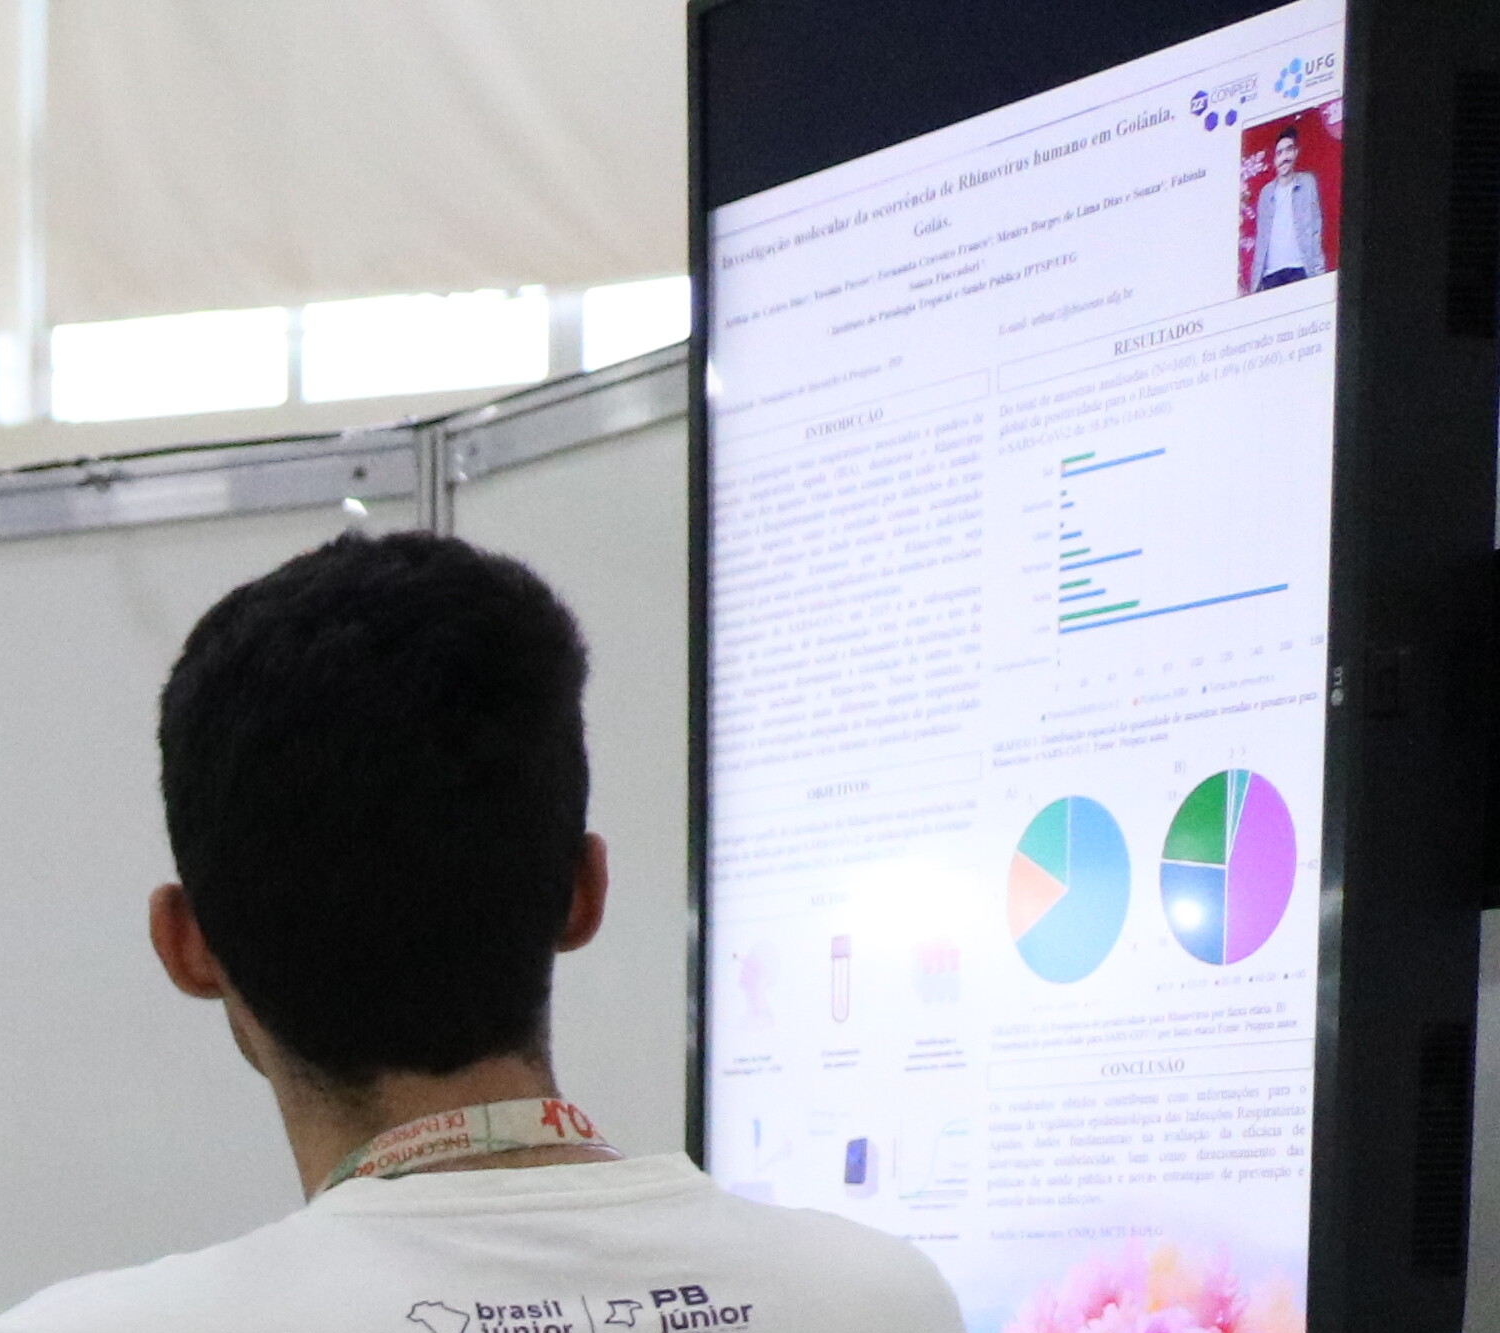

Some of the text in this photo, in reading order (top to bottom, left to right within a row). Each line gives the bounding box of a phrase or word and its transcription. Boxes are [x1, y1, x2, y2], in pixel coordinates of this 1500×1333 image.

[1305, 53, 1335, 75] UFG
[794, 217, 849, 246] molecular
[854, 209, 868, 226] da
[940, 180, 953, 197] de
[1034, 138, 1087, 166] humano
[1091, 130, 1111, 147] em
[1116, 109, 1175, 138] Goiânia,
[1114, 319, 1203, 356] RESULTADOS
[1220, 333, 1274, 359] observado
[1105, 395, 1125, 412] para
[1197, 369, 1209, 384] de
[1298, 343, 1322, 361] para
[1101, 1058, 1185, 1077] CONCLUSÃO
[1197, 1085, 1259, 1100] informações
[1268, 1086, 1290, 1098] para
[1299, 1085, 1306, 1093] o
[1220, 1127, 1231, 1139] da
[1293, 1124, 1305, 1135] de
[1197, 1146, 1276, 1160] direcionamento
[1286, 1145, 1304, 1156] das
[1221, 1167, 1233, 1179] de
[1238, 1166, 1291, 1181] prevenção
[1298, 1168, 1304, 1176] e
[648, 1285, 709, 1307] PB
[475, 1300, 562, 1322] brasil
